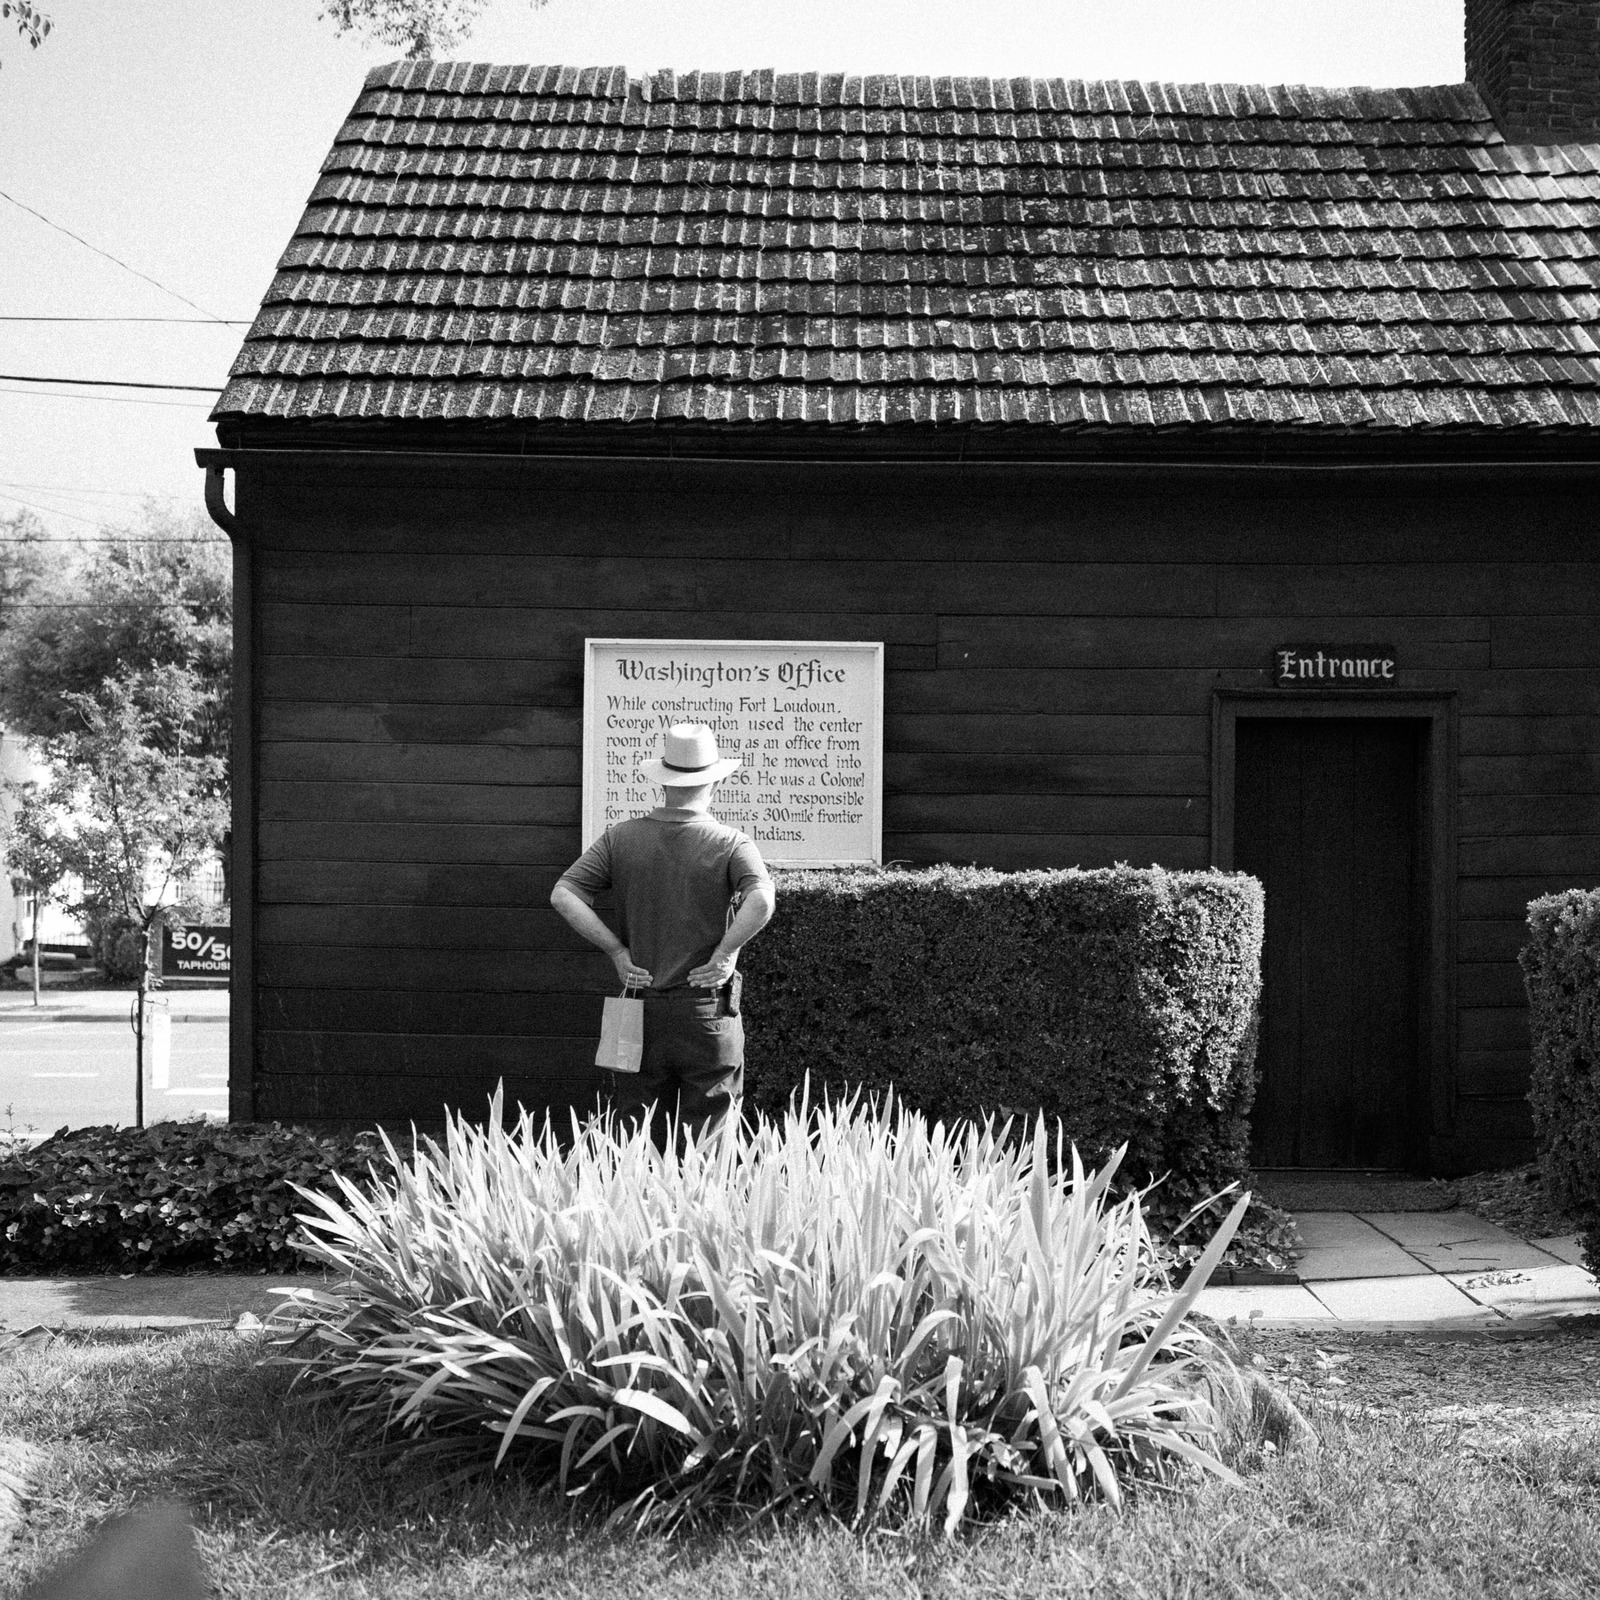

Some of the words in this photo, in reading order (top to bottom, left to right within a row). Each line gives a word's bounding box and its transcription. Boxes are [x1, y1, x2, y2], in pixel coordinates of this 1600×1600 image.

[616, 659, 769, 688] Washington's
[777, 658, 846, 690] Office
[1277, 651, 1394, 679] Entrance
[607, 696, 646, 711] While
[652, 696, 733, 716] constructing
[739, 697, 766, 712] Fort
[606, 714, 655, 734] George
[748, 716, 784, 731] used
[794, 716, 814, 732] the
[820, 718, 862, 732] center
[606, 736, 641, 747] room
[646, 733, 658, 748] of
[745, 738, 760, 749] as
[764, 738, 779, 750] an
[785, 734, 822, 750] office
[827, 736, 860, 750] from
[606, 750, 626, 765] the
[724, 752, 754, 767] til
[762, 752, 778, 768] he
[784, 754, 828, 768] moved
[836, 754, 862, 769] into
[606, 770, 628, 783] the
[757, 770, 777, 786] He
[780, 776, 804, 786] was
[808, 777, 816, 786] a
[820, 772, 865, 788] Colonel
[606, 788, 619, 802] in
[626, 788, 647, 802] the
[756, 790, 782, 804] and
[789, 791, 864, 809] responsible
[605, 806, 624, 820] for
[710, 807, 758, 824] irginia's
[818, 808, 863, 824] frontier
[754, 826, 805, 842] Indians.
[171, 931, 230, 961] 50/5
